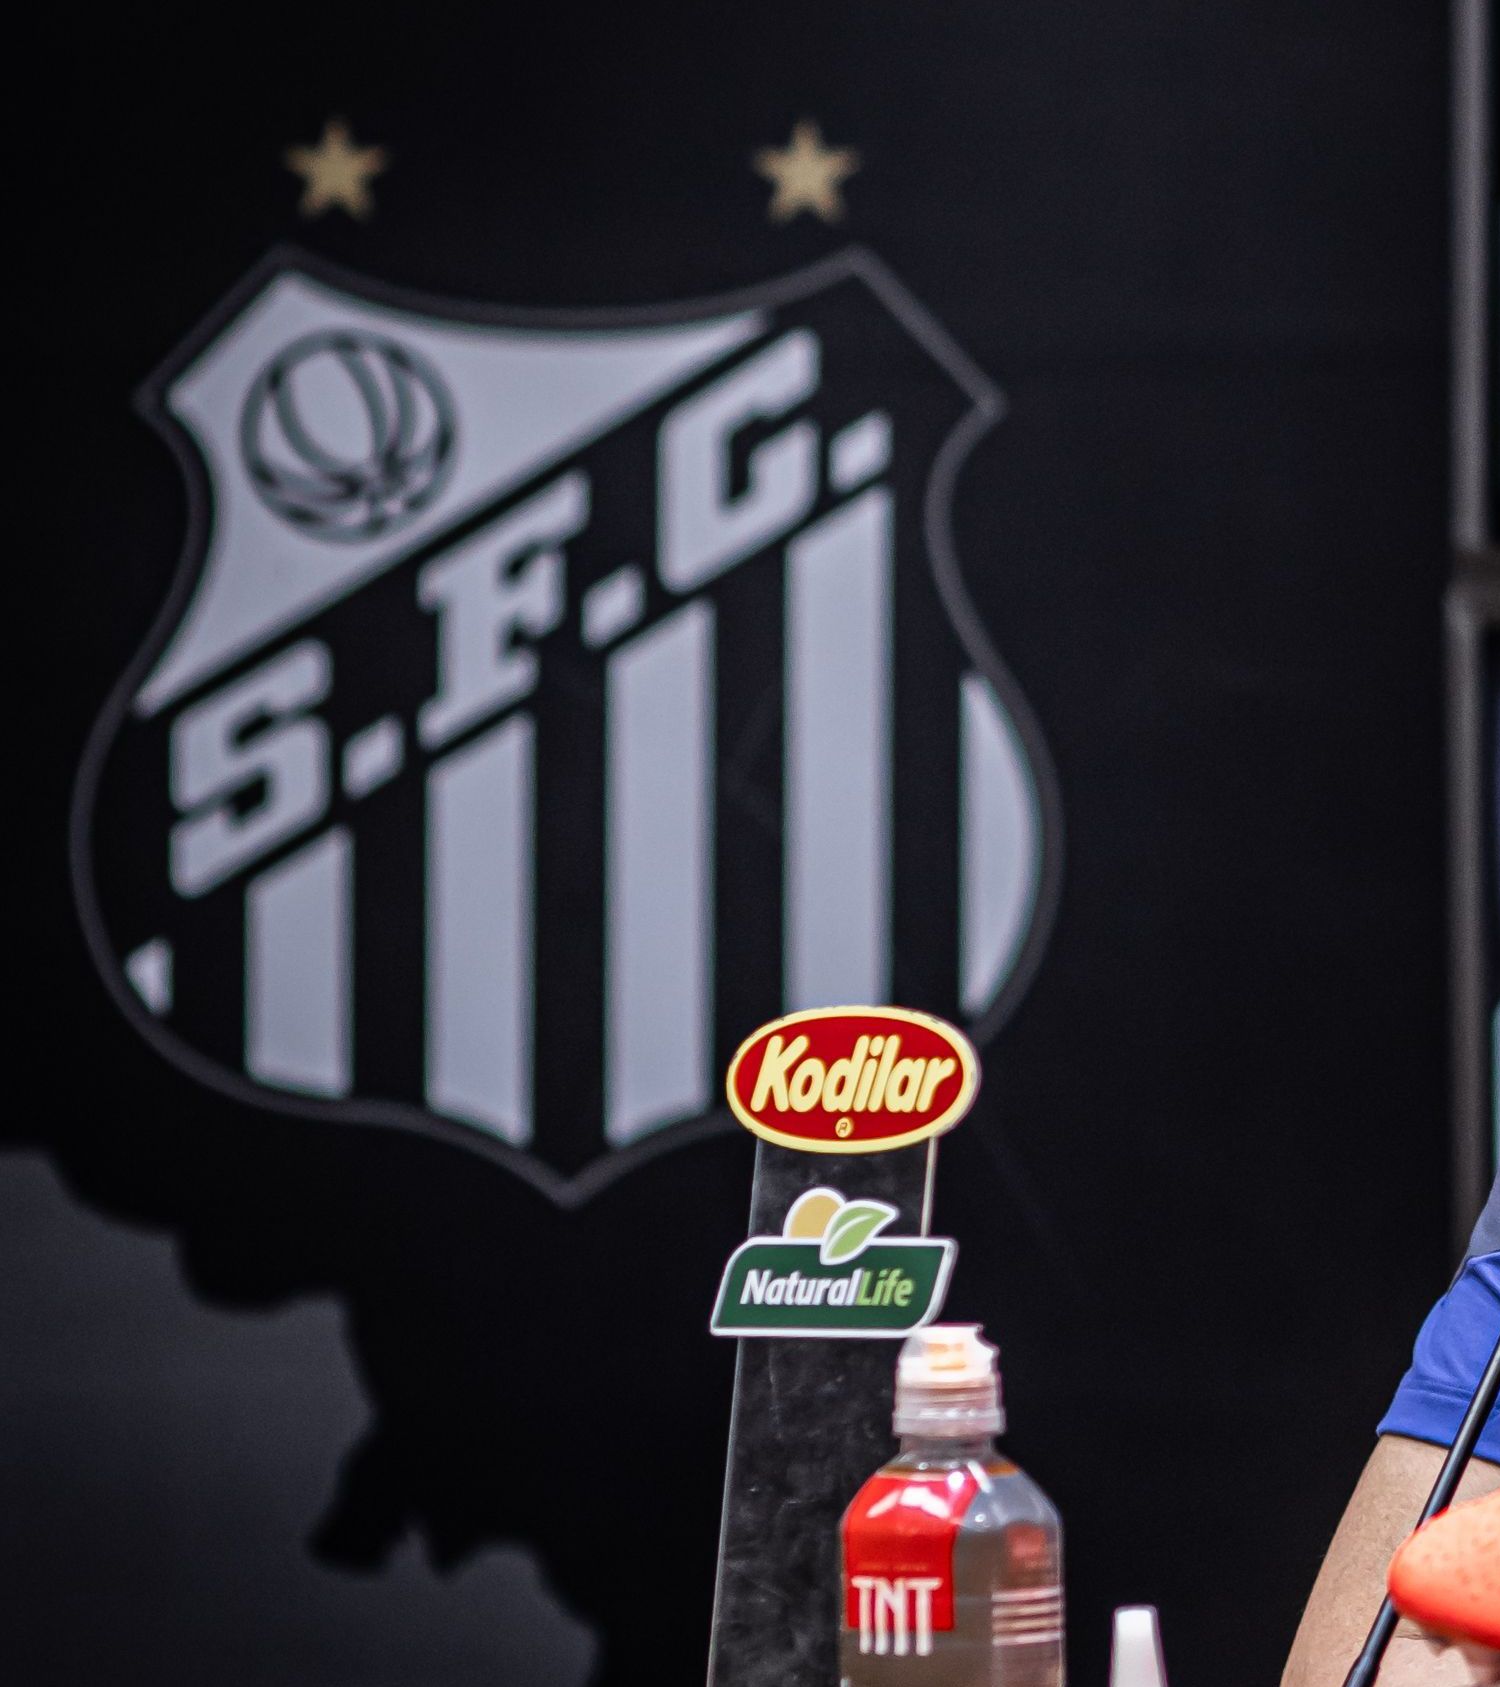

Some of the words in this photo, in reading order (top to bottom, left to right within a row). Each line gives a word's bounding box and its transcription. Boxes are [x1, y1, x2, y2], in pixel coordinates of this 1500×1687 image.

[168, 325, 895, 900] S.F.C.
[750, 1034, 956, 1113] Kodilar
[740, 1267, 915, 1307] NaturalLife
[850, 1576, 944, 1657] TNT
